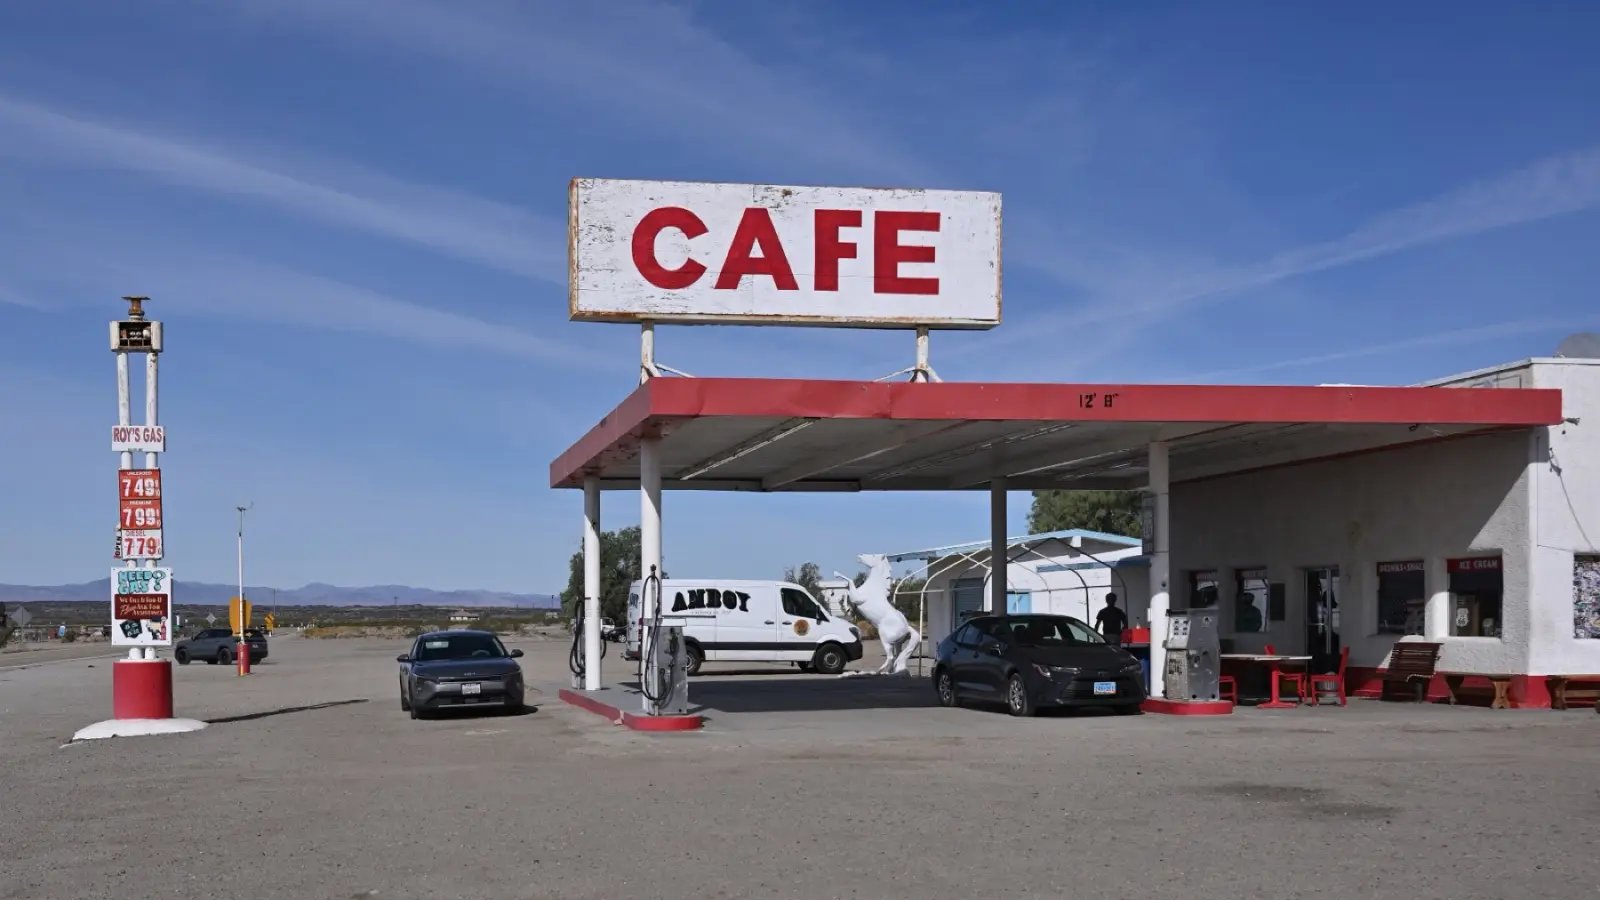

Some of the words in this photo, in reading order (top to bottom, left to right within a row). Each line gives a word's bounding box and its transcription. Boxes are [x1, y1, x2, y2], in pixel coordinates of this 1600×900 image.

[632, 206, 941, 295] CAFE
[113, 427, 141, 443] ROY'S
[143, 427, 162, 443] GAS
[1474, 559, 1498, 569] CREAM
[118, 570, 153, 583] NEED
[118, 580, 149, 594] GAS
[671, 588, 751, 612] AMBOY
